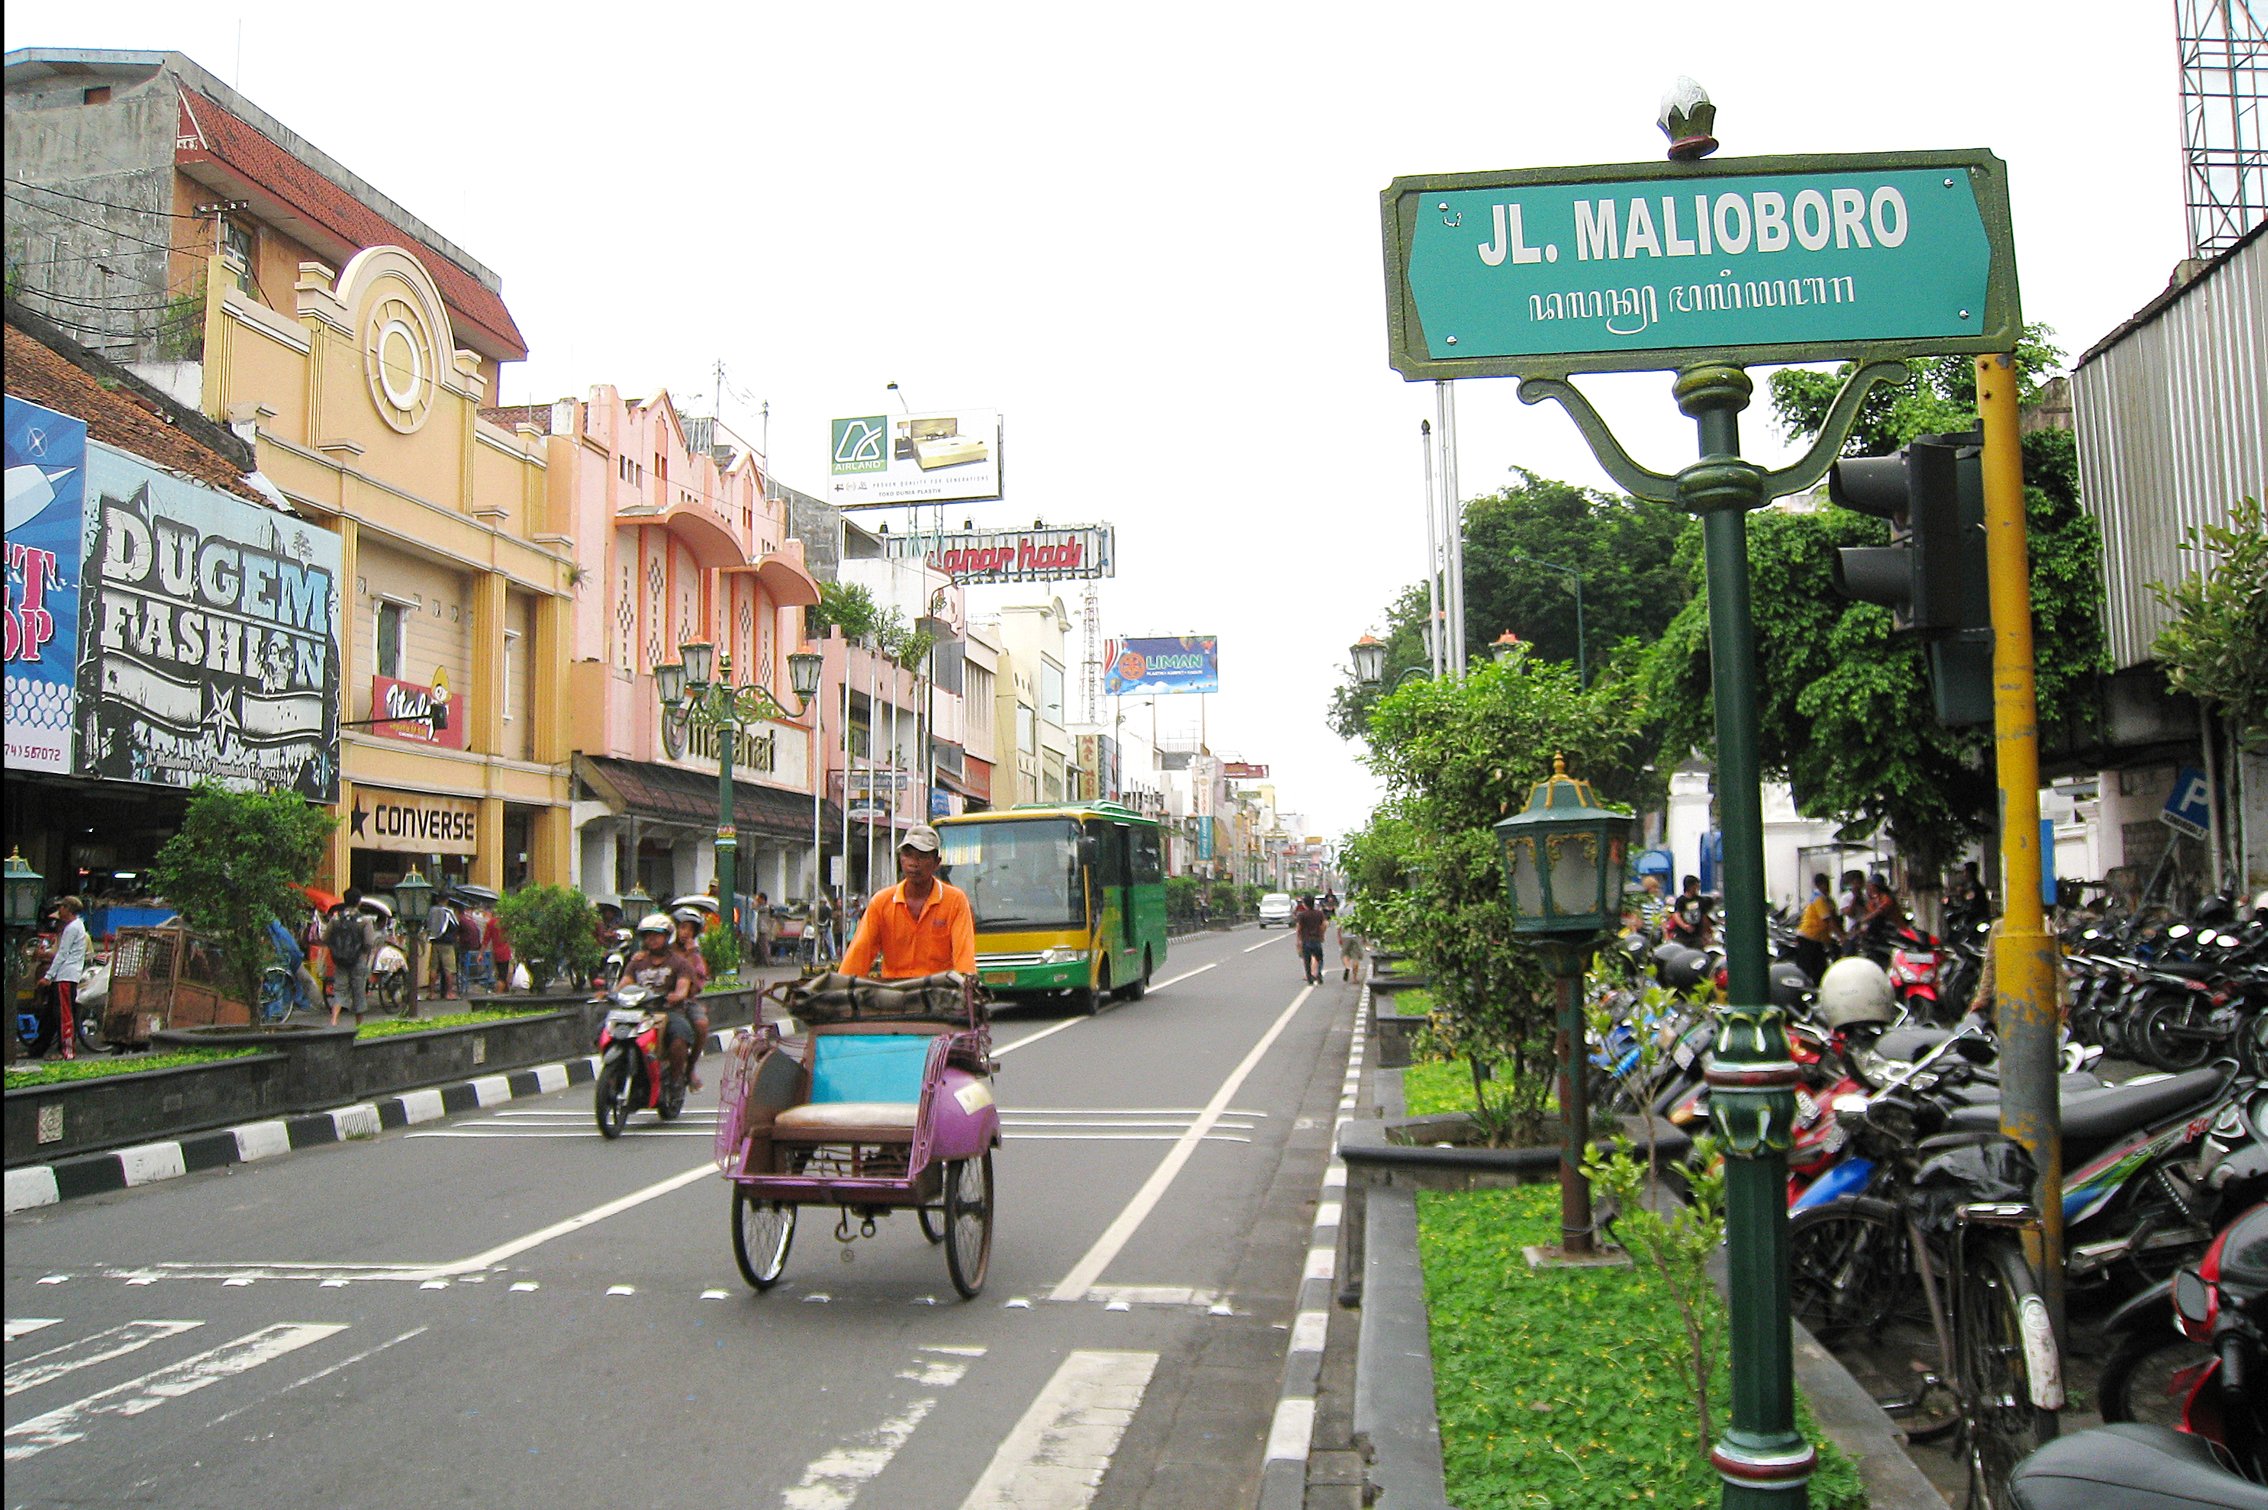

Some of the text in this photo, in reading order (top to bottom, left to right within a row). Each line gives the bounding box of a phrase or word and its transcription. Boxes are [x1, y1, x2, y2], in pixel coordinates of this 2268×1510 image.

[1477, 185, 1909, 266] JL. MALIOBORO
[835, 461, 880, 471] AIRLAND
[102, 506, 329, 634] DUGEM
[1017, 535, 1083, 570] hadi
[1146, 654, 1203, 670] LIMAN
[2179, 777, 2210, 812] P
[375, 804, 475, 841] CONVERSE
